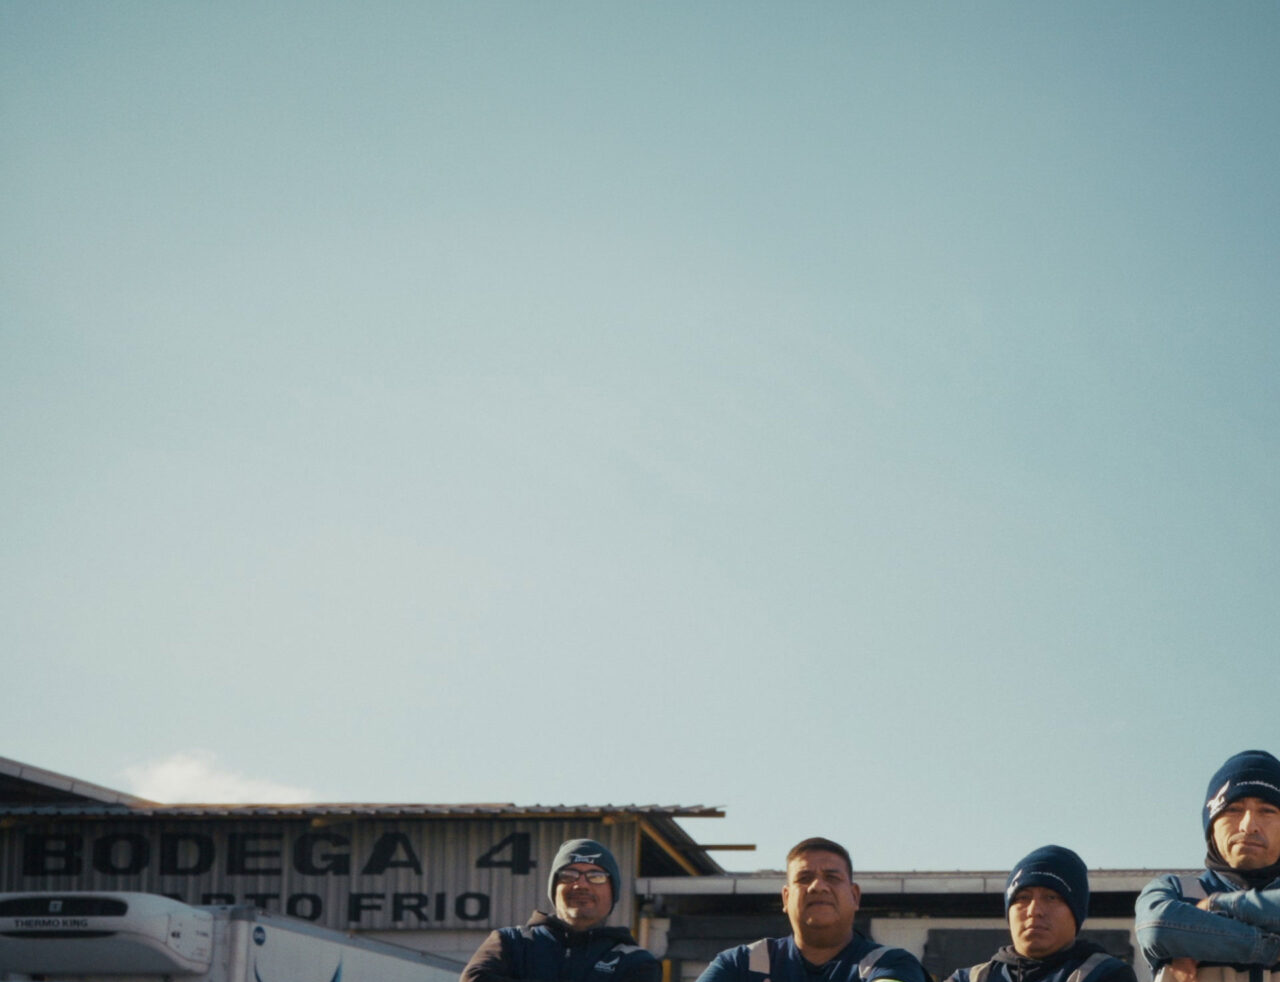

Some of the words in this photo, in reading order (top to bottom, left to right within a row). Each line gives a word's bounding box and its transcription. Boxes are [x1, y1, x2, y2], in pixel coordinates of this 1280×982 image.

[22, 832, 423, 875] BODEGA
[475, 832, 538, 875] 4
[348, 892, 492, 922] FRIO
[14, 919, 60, 928] THERMO
[62, 919, 88, 928] KING
